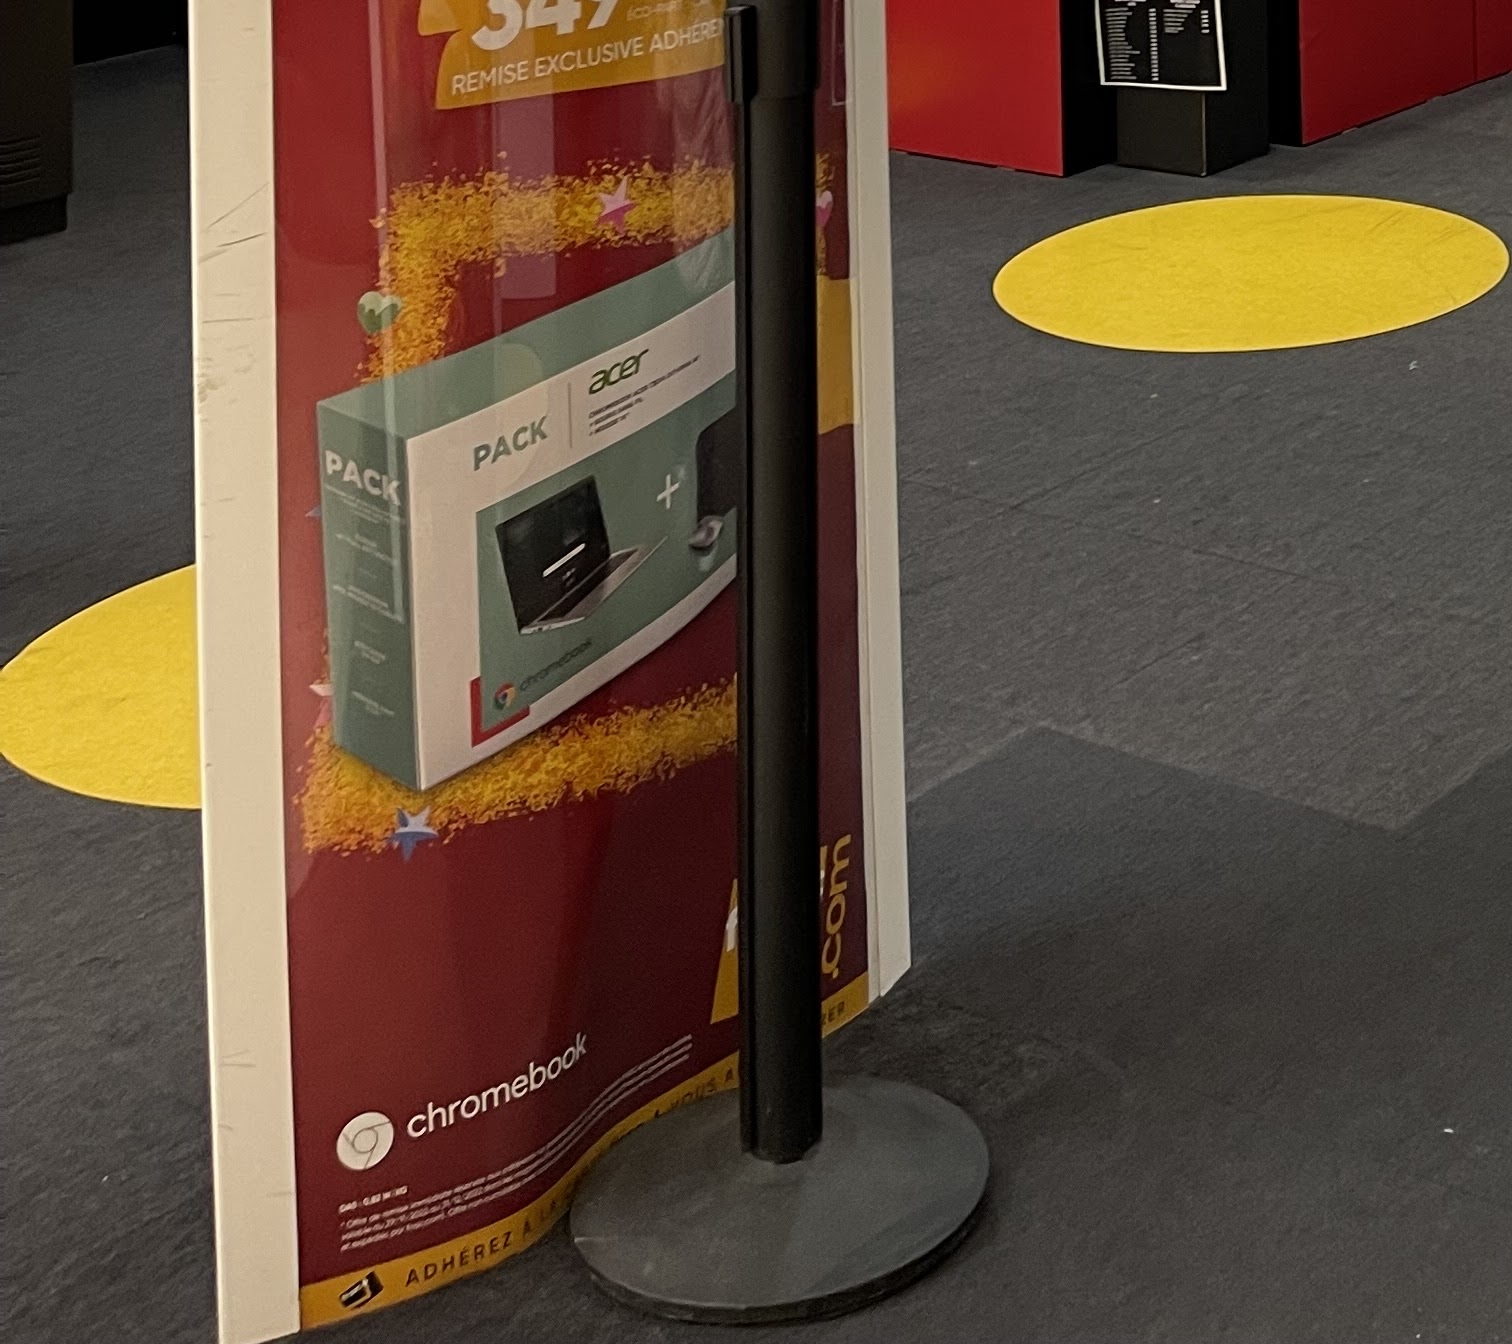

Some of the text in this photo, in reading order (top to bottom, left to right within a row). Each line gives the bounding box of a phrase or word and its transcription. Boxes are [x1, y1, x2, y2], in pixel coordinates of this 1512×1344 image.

[451, 60, 529, 96] REMISE
[535, 35, 644, 79] EXCLUSIVE
[588, 348, 649, 395] acer
[473, 415, 548, 472] PACK
[325, 449, 401, 506] PACK
[406, 1032, 588, 1139] chromebook
[404, 1230, 513, 1288] ADHÉREZ
